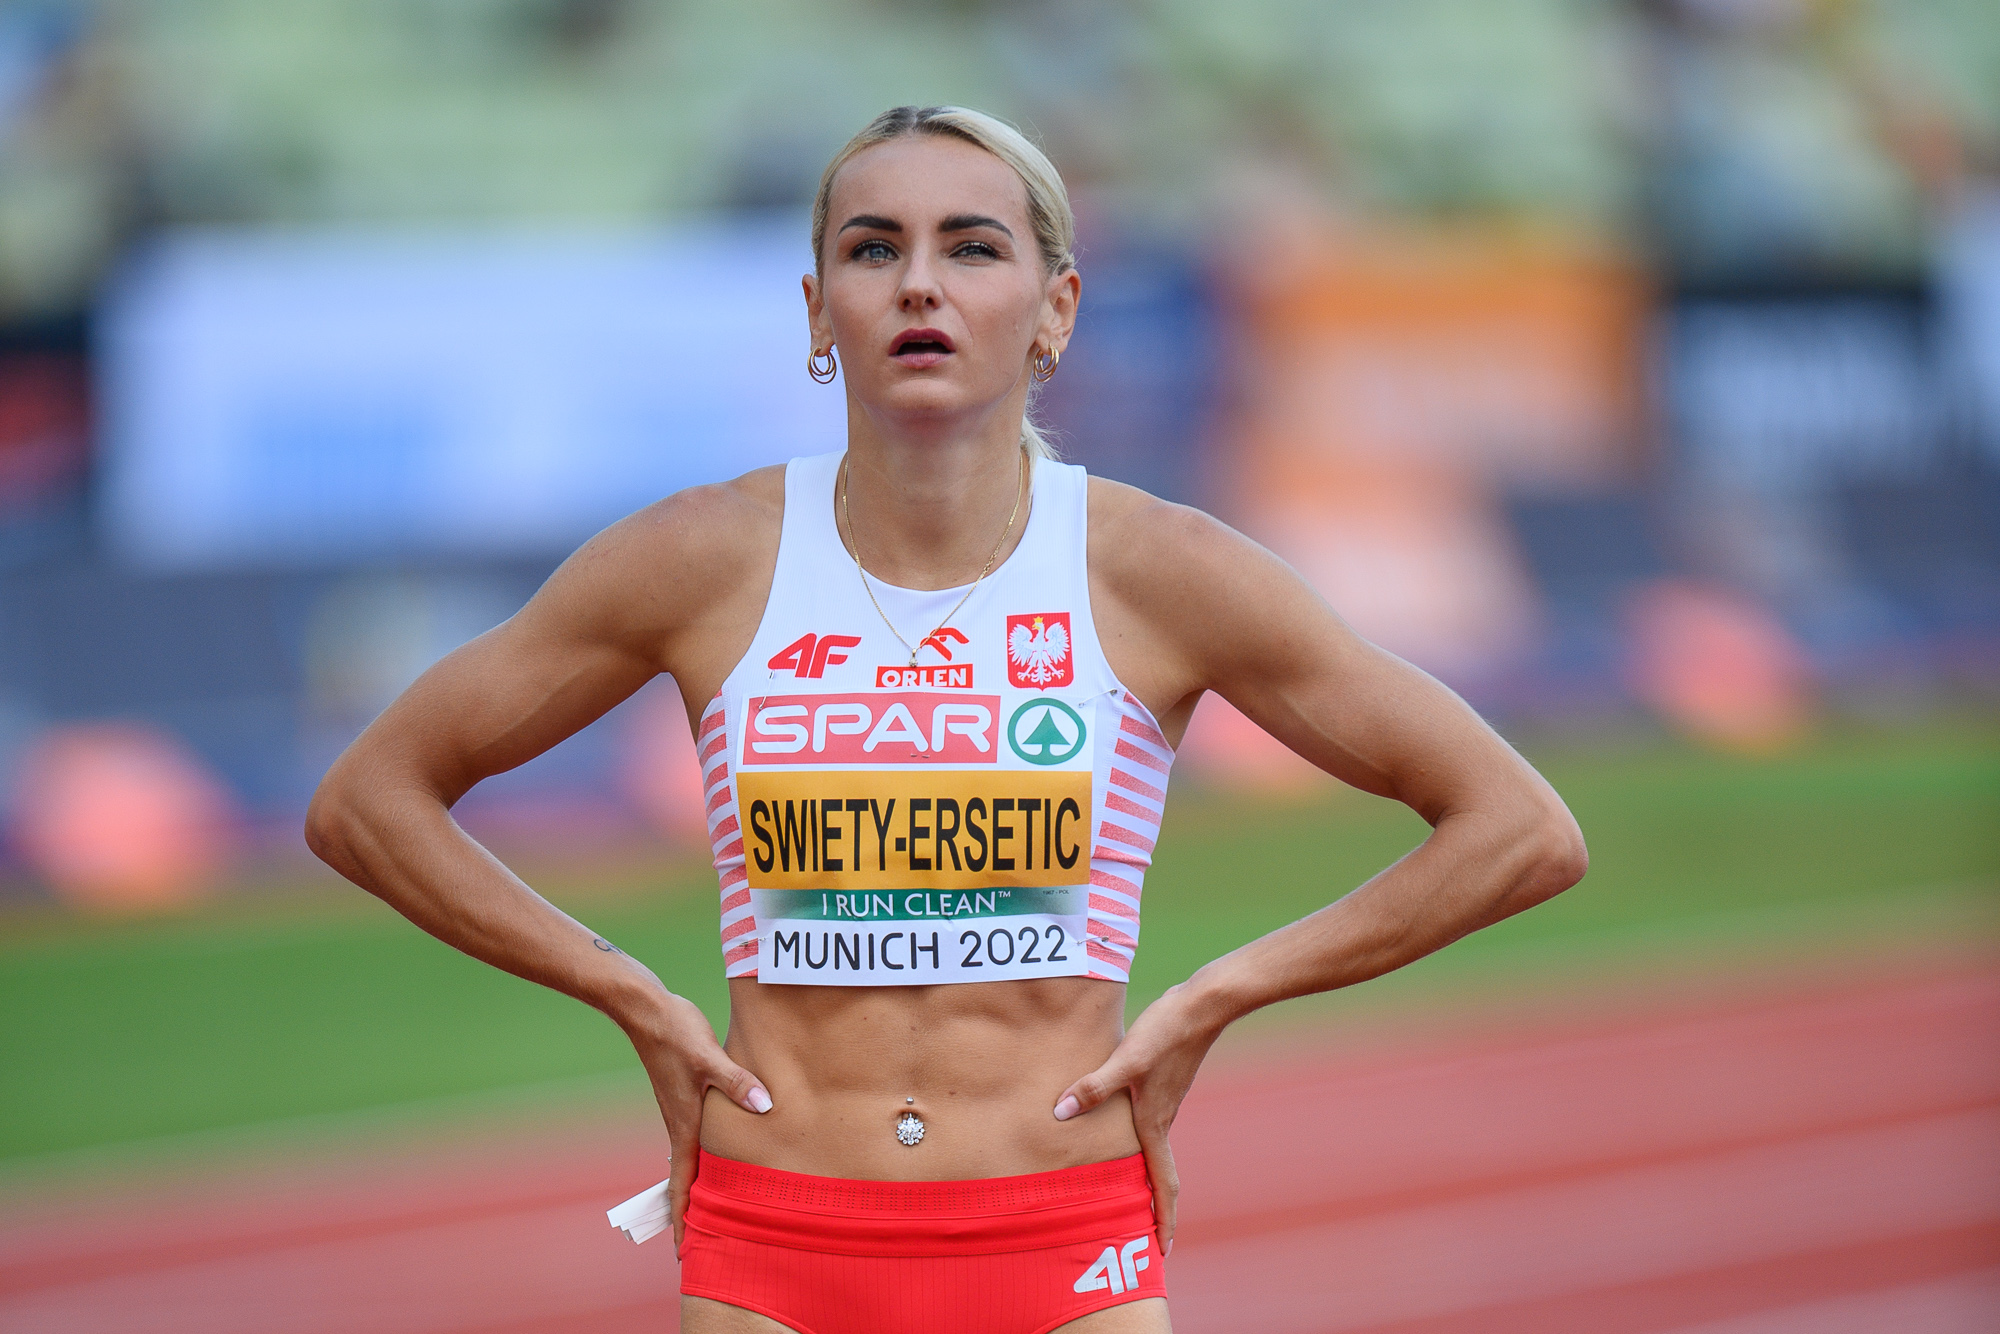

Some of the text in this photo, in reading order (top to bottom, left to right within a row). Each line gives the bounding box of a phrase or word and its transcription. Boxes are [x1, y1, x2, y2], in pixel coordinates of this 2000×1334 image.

[767, 633, 862, 679] 4F
[880, 668, 968, 687] ORLEN
[751, 703, 992, 754] SPAR
[750, 797, 1081, 873] SWIETY-ERSETIC
[822, 893, 828, 916] I
[836, 893, 894, 918] RUN
[774, 924, 1068, 970] MUNICH 2022
[1073, 1235, 1149, 1295] 4F
